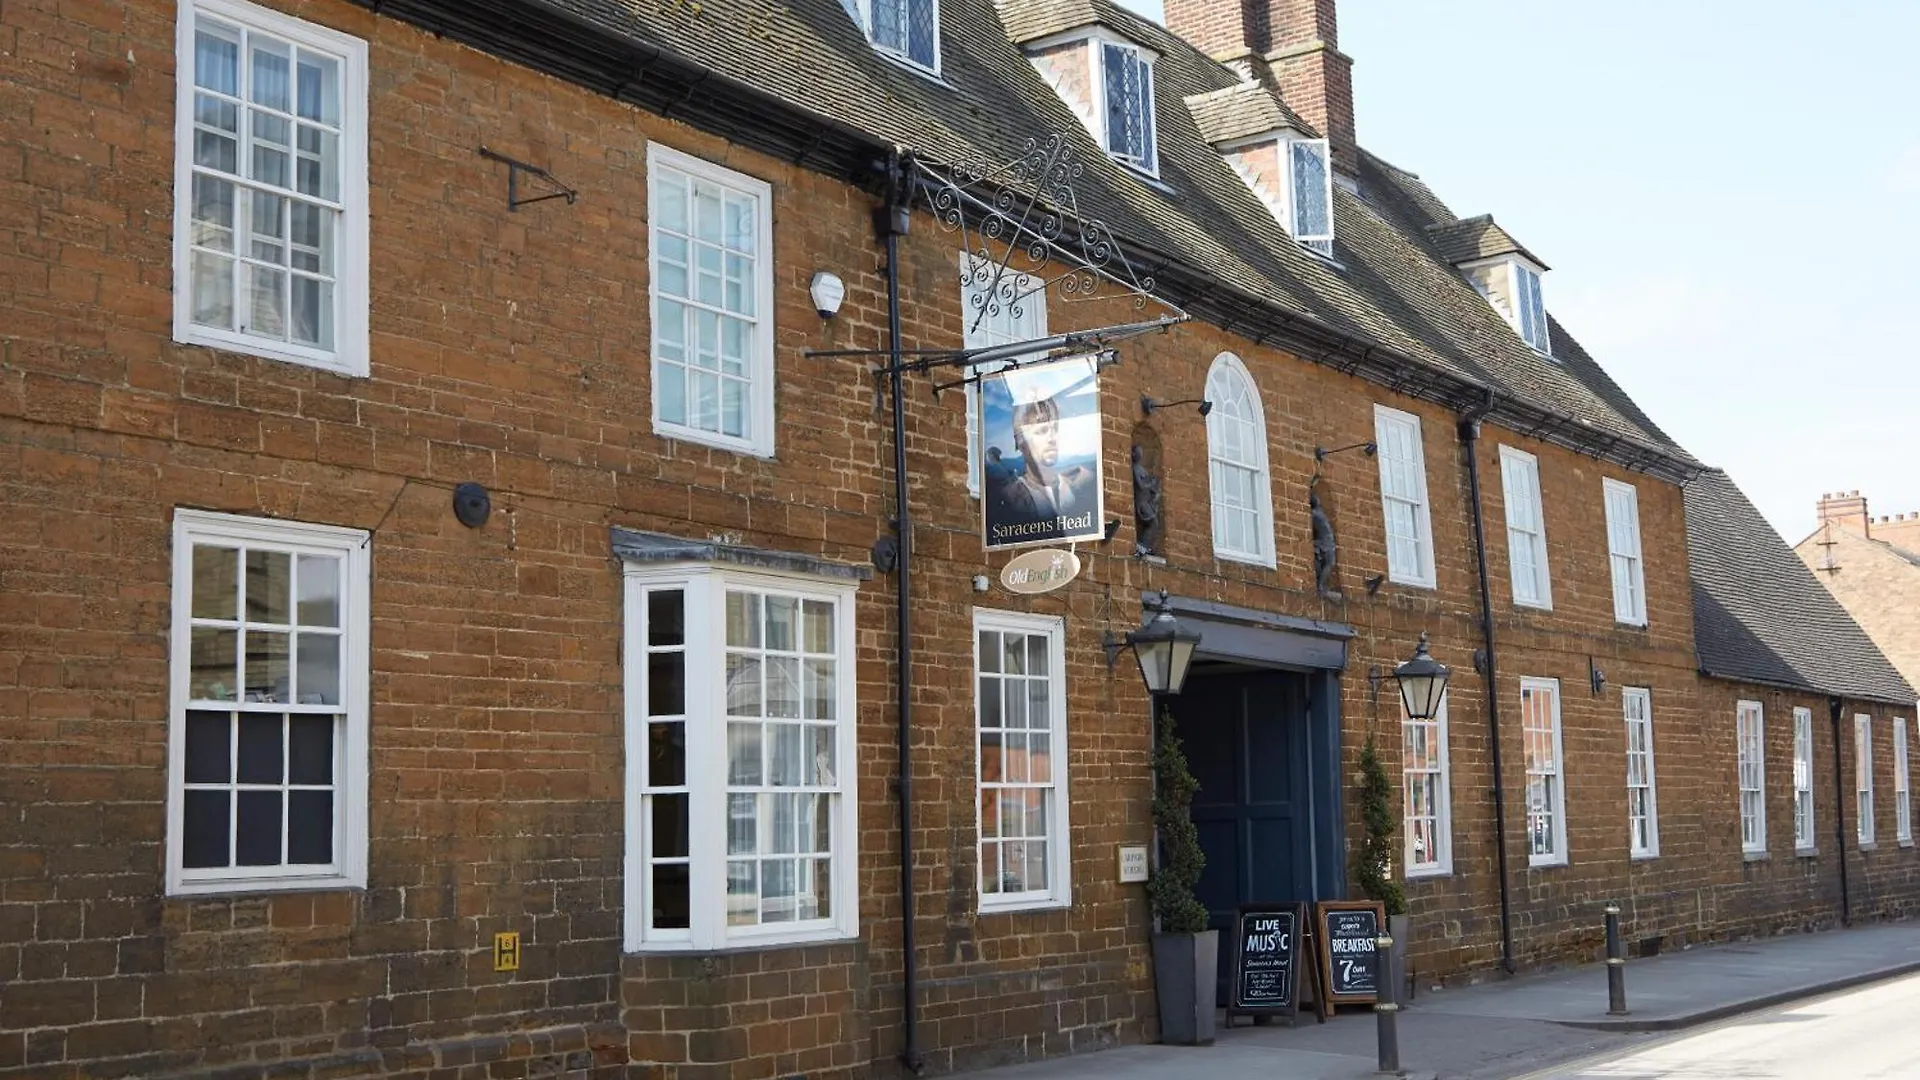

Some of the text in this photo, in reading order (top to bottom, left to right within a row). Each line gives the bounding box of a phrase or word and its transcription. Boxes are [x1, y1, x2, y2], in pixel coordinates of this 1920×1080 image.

[993, 511, 1091, 538] Saracens Head
[1255, 919, 1280, 931] LIVE
[1332, 937, 1375, 952] BREAKFAST
